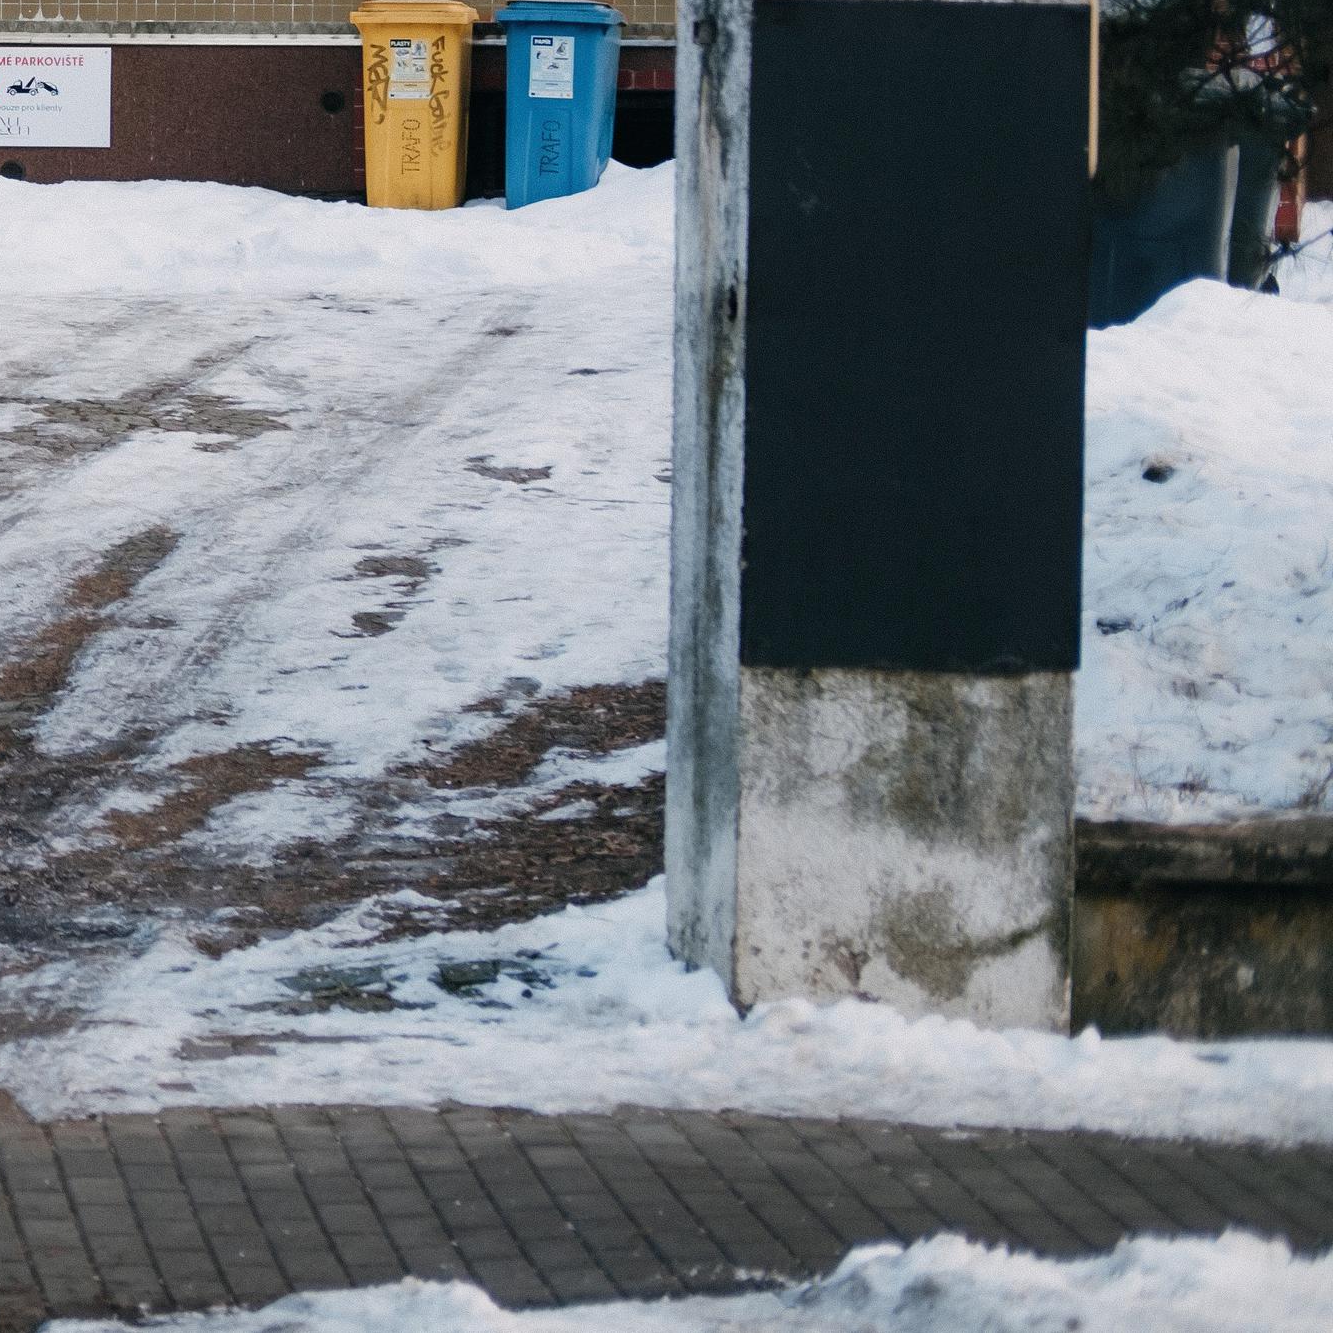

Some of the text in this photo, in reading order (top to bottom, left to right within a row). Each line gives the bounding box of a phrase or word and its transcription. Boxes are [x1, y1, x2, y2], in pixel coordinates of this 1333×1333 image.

[15, 54, 84, 67] PARKOVIŠTĚ
[21, 105, 35, 113] pro
[36, 103, 63, 113] klienty
[401, 118, 421, 175] TRAFO
[539, 119, 561, 176] TRAFO
